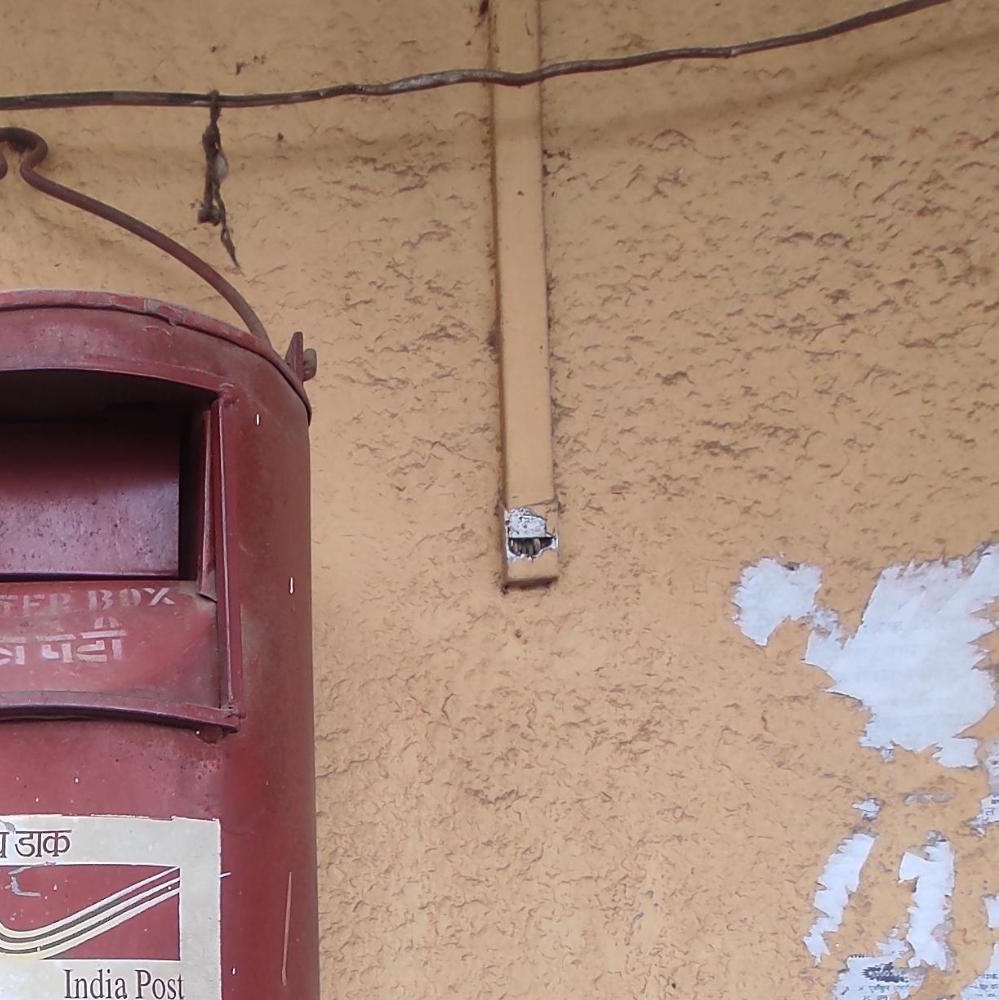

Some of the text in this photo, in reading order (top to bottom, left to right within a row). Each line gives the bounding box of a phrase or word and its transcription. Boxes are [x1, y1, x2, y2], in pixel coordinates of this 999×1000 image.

[87, 586, 176, 611] BOX
[14, 828, 73, 858] डाक
[63, 968, 185, 1000] India Post
